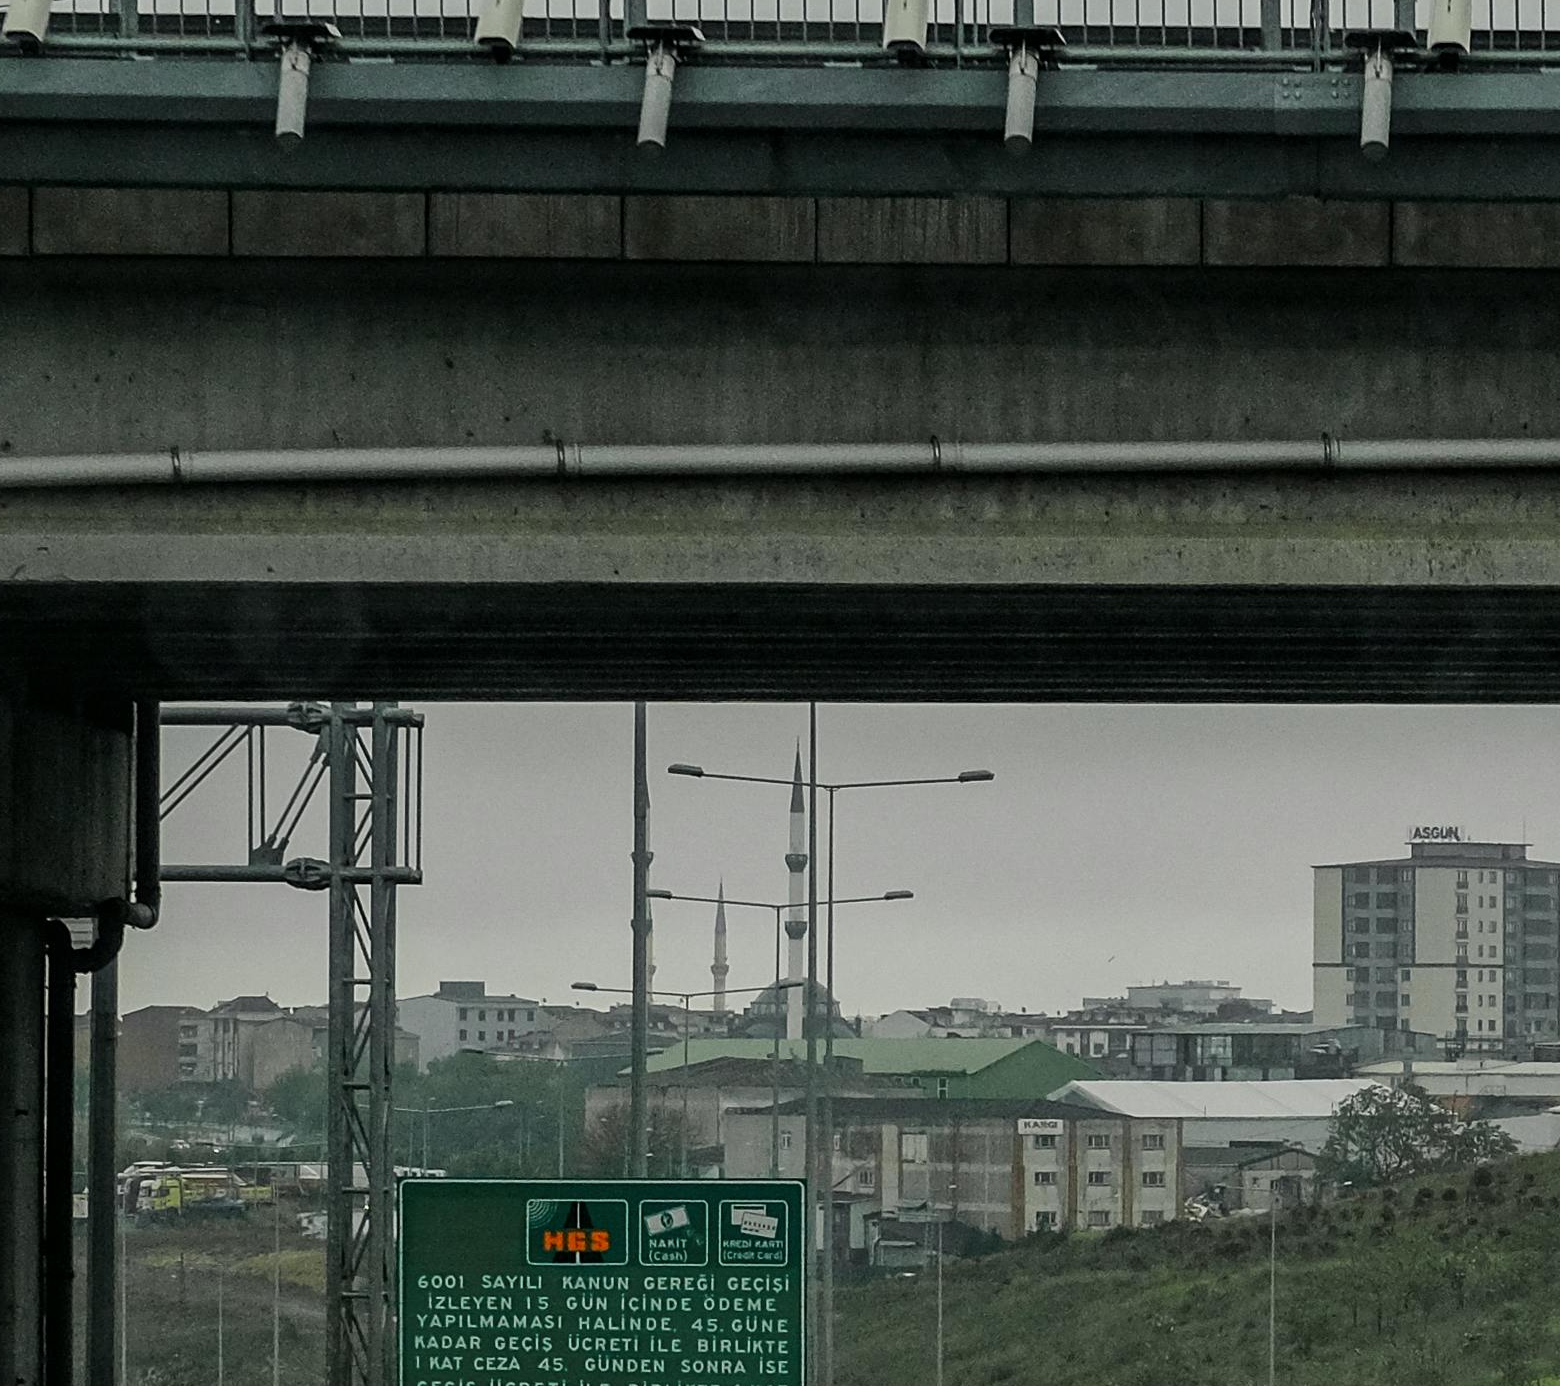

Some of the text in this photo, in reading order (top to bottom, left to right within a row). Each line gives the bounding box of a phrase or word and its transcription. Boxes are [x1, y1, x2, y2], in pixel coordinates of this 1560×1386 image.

[545, 1232, 609, 1251] HGS
[649, 1251, 687, 1261] (Cash)
[418, 1275, 788, 1293] 6001 SAYILI KANUN GEREĞİ GEÇİŞİ
[429, 1296, 511, 1309] İZLEYEN
[567, 1297, 606, 1310] GÜN
[621, 1294, 691, 1311] İÇİNDE
[704, 1298, 776, 1311] ÖDEME
[417, 1315, 561, 1328] YAPILMAMASI
[732, 1316, 787, 1332] GÜNE
[415, 1334, 788, 1353] KADAR GEÇİŞ ÜCRETİ İLE BİRLİKTE
[417, 1356, 419, 1368] 1
[430, 1357, 462, 1369] KAT
[474, 1357, 520, 1370] CEZA
[585, 1355, 664, 1372] GÜNDEN
[682, 1360, 745, 1373] SONRA
[760, 1357, 788, 1373] İSE
